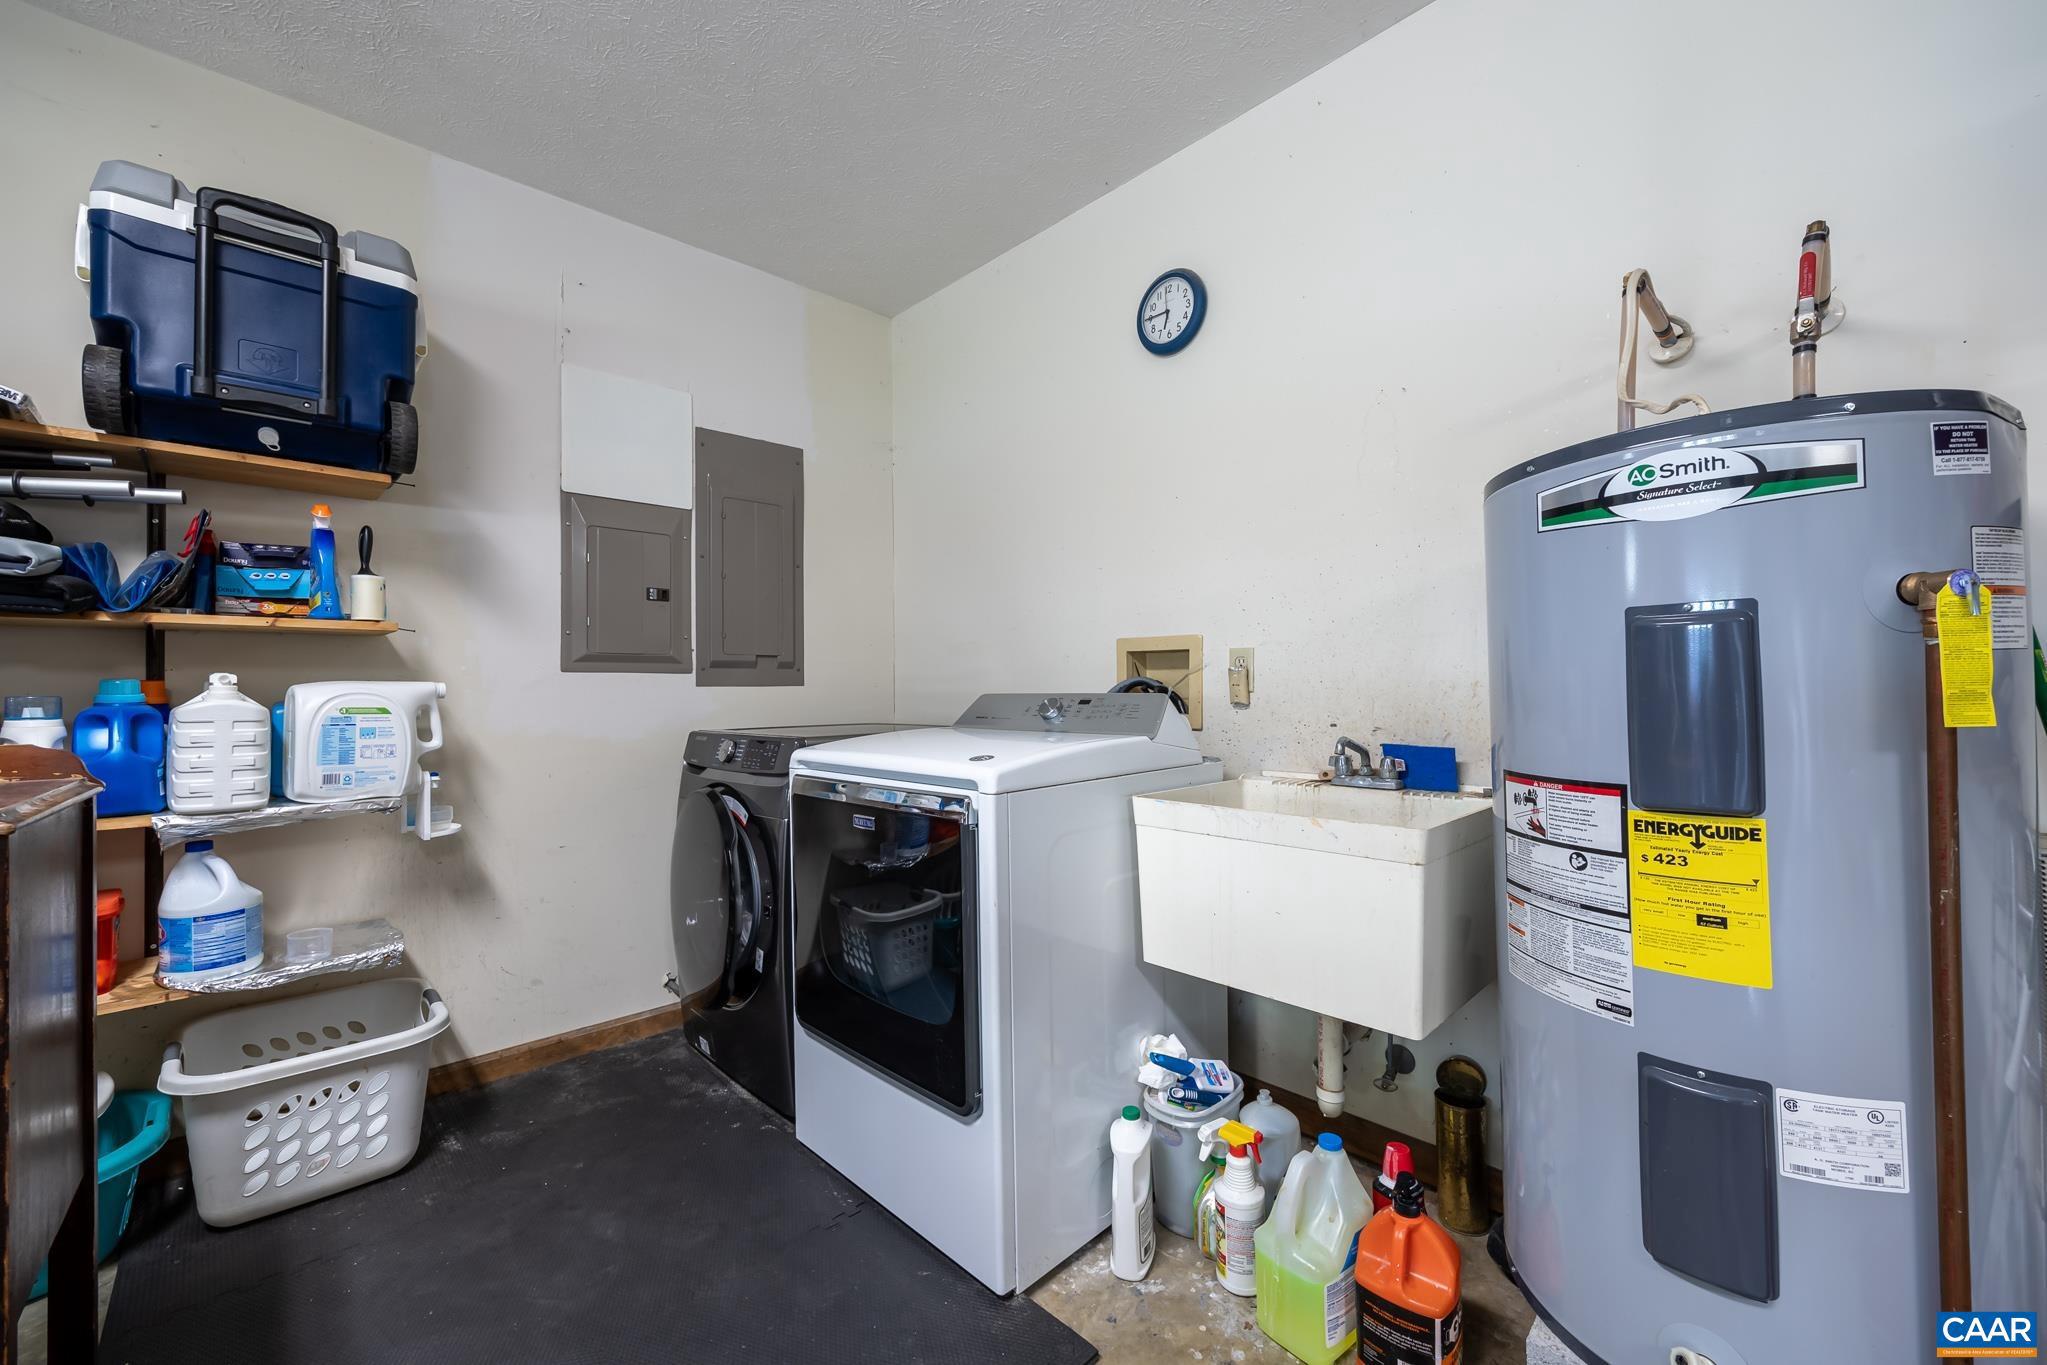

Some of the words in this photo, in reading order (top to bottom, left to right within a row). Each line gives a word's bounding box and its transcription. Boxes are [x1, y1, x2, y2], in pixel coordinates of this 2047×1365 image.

[1157, 292, 1162, 301] 11
[1183, 288, 1188, 298] 2
[1150, 303, 1157, 313] 10
[1186, 299, 1191, 308] 3
[1183, 312, 1188, 320] 4
[1151, 325, 1156, 334] 8
[1177, 322, 1182, 332] 5
[1158, 330, 1163, 339] 7
[1167, 330, 1172, 339] 6
[1637, 487, 1684, 500] Signature
[223, 556, 248, 566] Downy
[1540, 781, 1563, 790] DANGER
[1633, 819, 1762, 844] ENERGYGUIDE
[1675, 847, 1691, 855] Yearly
[1692, 848, 1710, 857] Energy
[1641, 853, 1649, 863] $
[1653, 853, 1689, 867] 423
[1703, 901, 1726, 909] Rating
